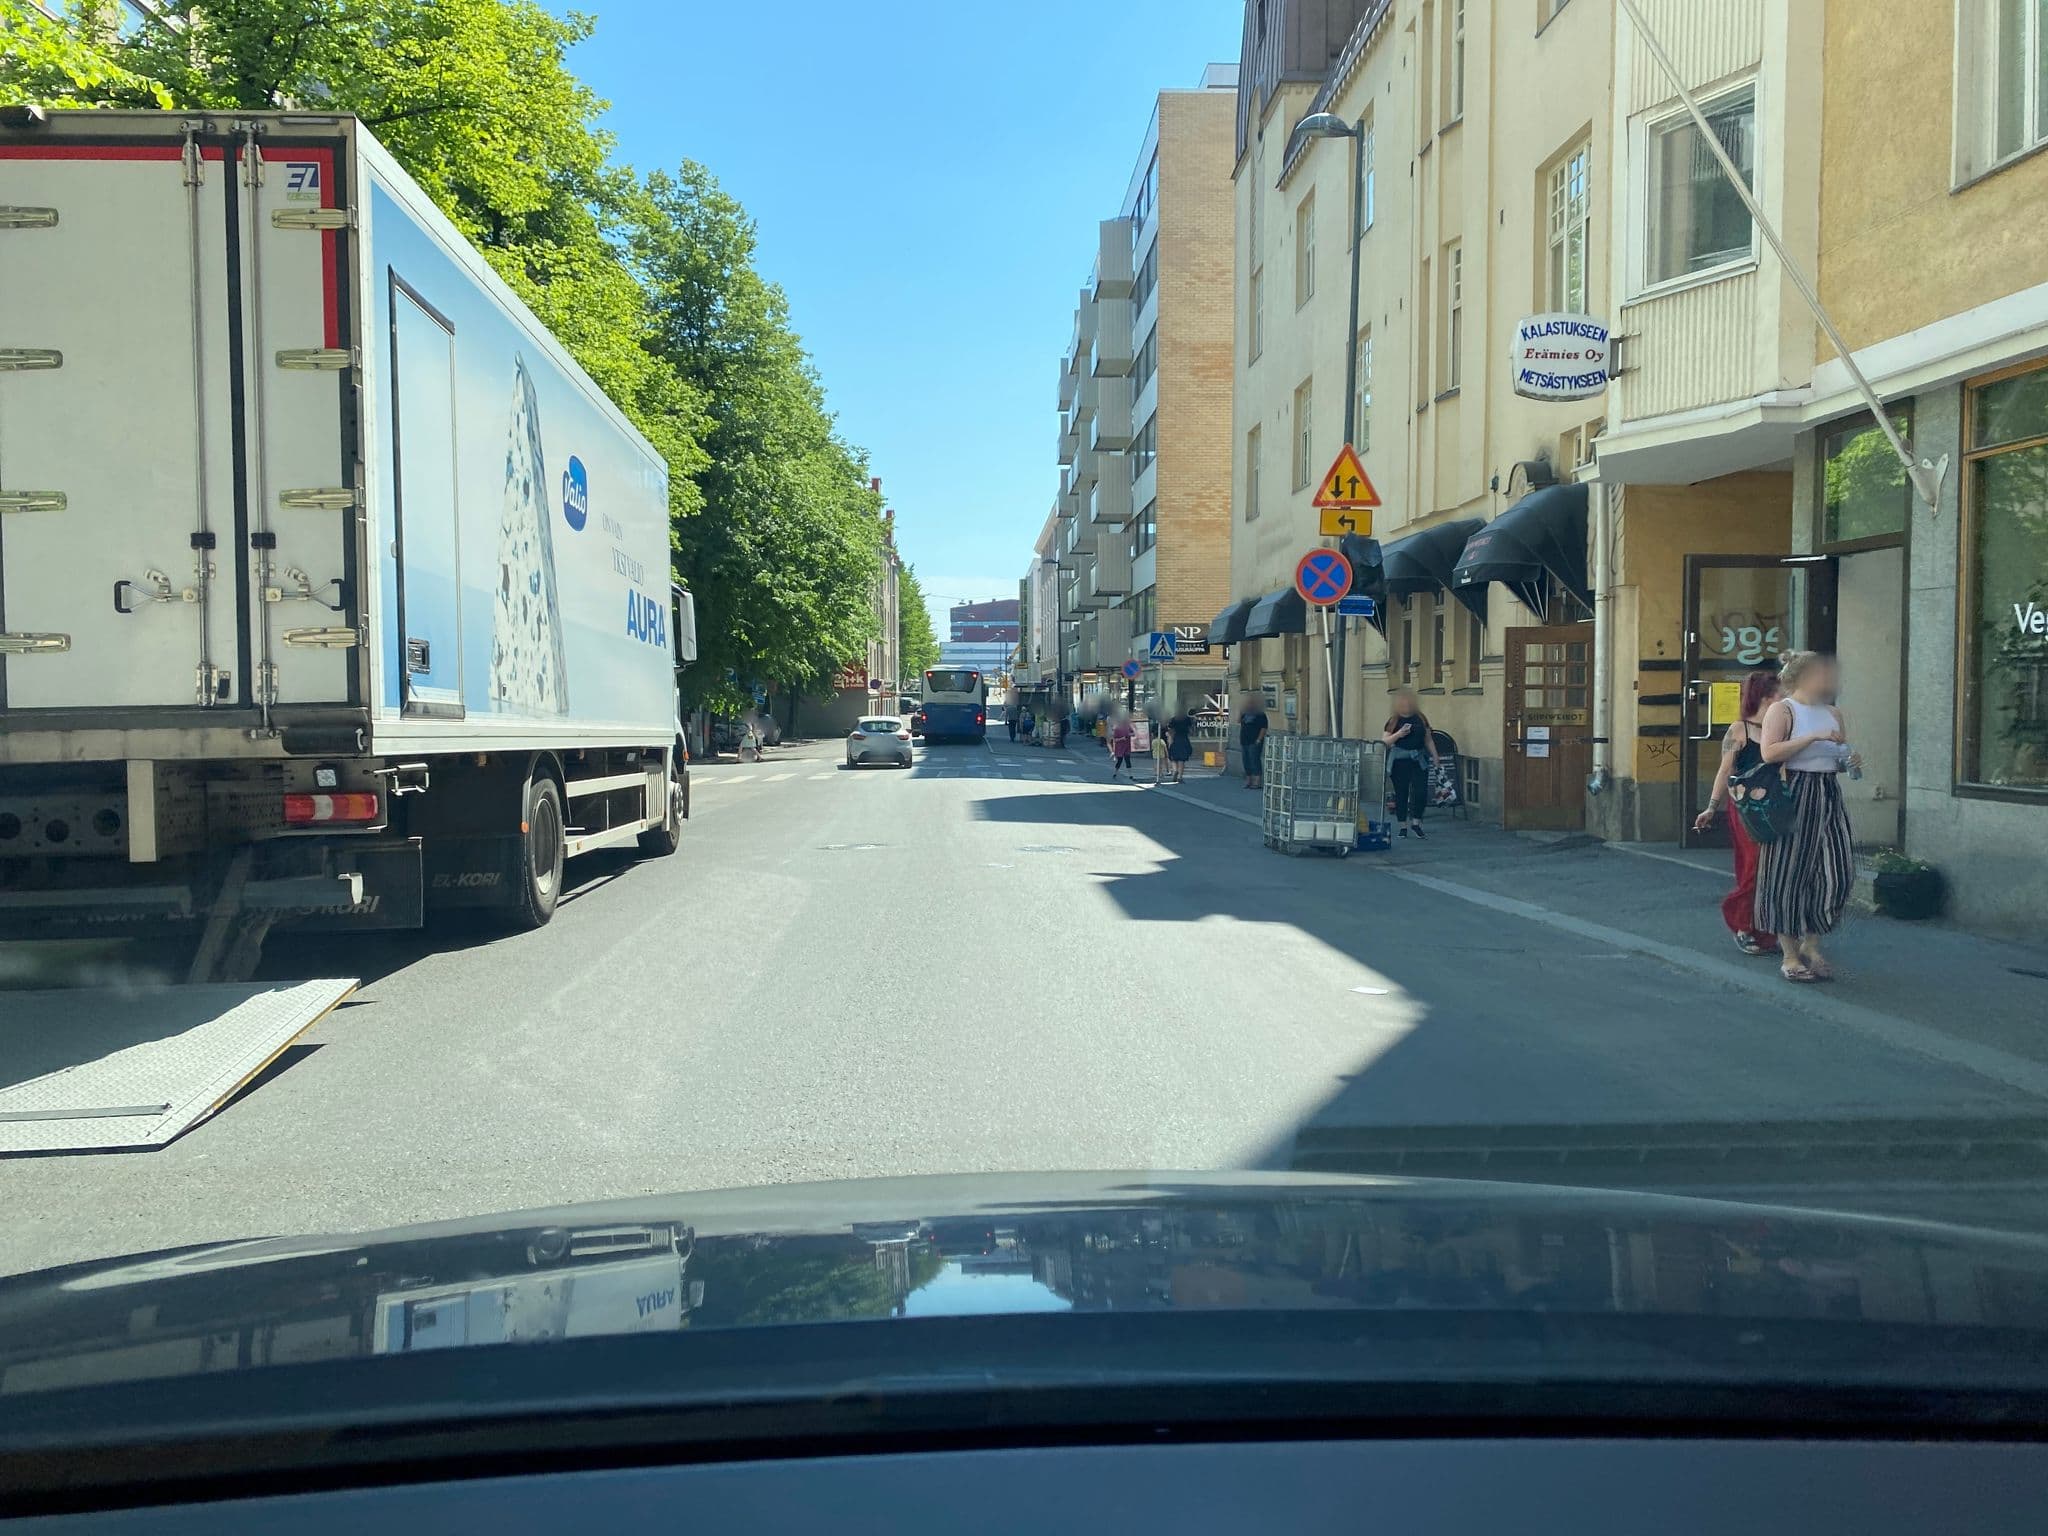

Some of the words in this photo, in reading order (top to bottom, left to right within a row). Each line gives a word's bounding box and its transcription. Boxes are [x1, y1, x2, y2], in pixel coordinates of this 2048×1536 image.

[1521, 321, 1608, 342] KALASTUKSEEN
[1524, 348, 1580, 360] Erämies
[1585, 349, 1604, 362] Oy
[1520, 368, 1608, 390] METSÄSTYKSEEN
[564, 477, 587, 515] Valio
[627, 589, 667, 648] AURA
[2013, 602, 2048, 641] Ve
[1173, 626, 1202, 639] NP
